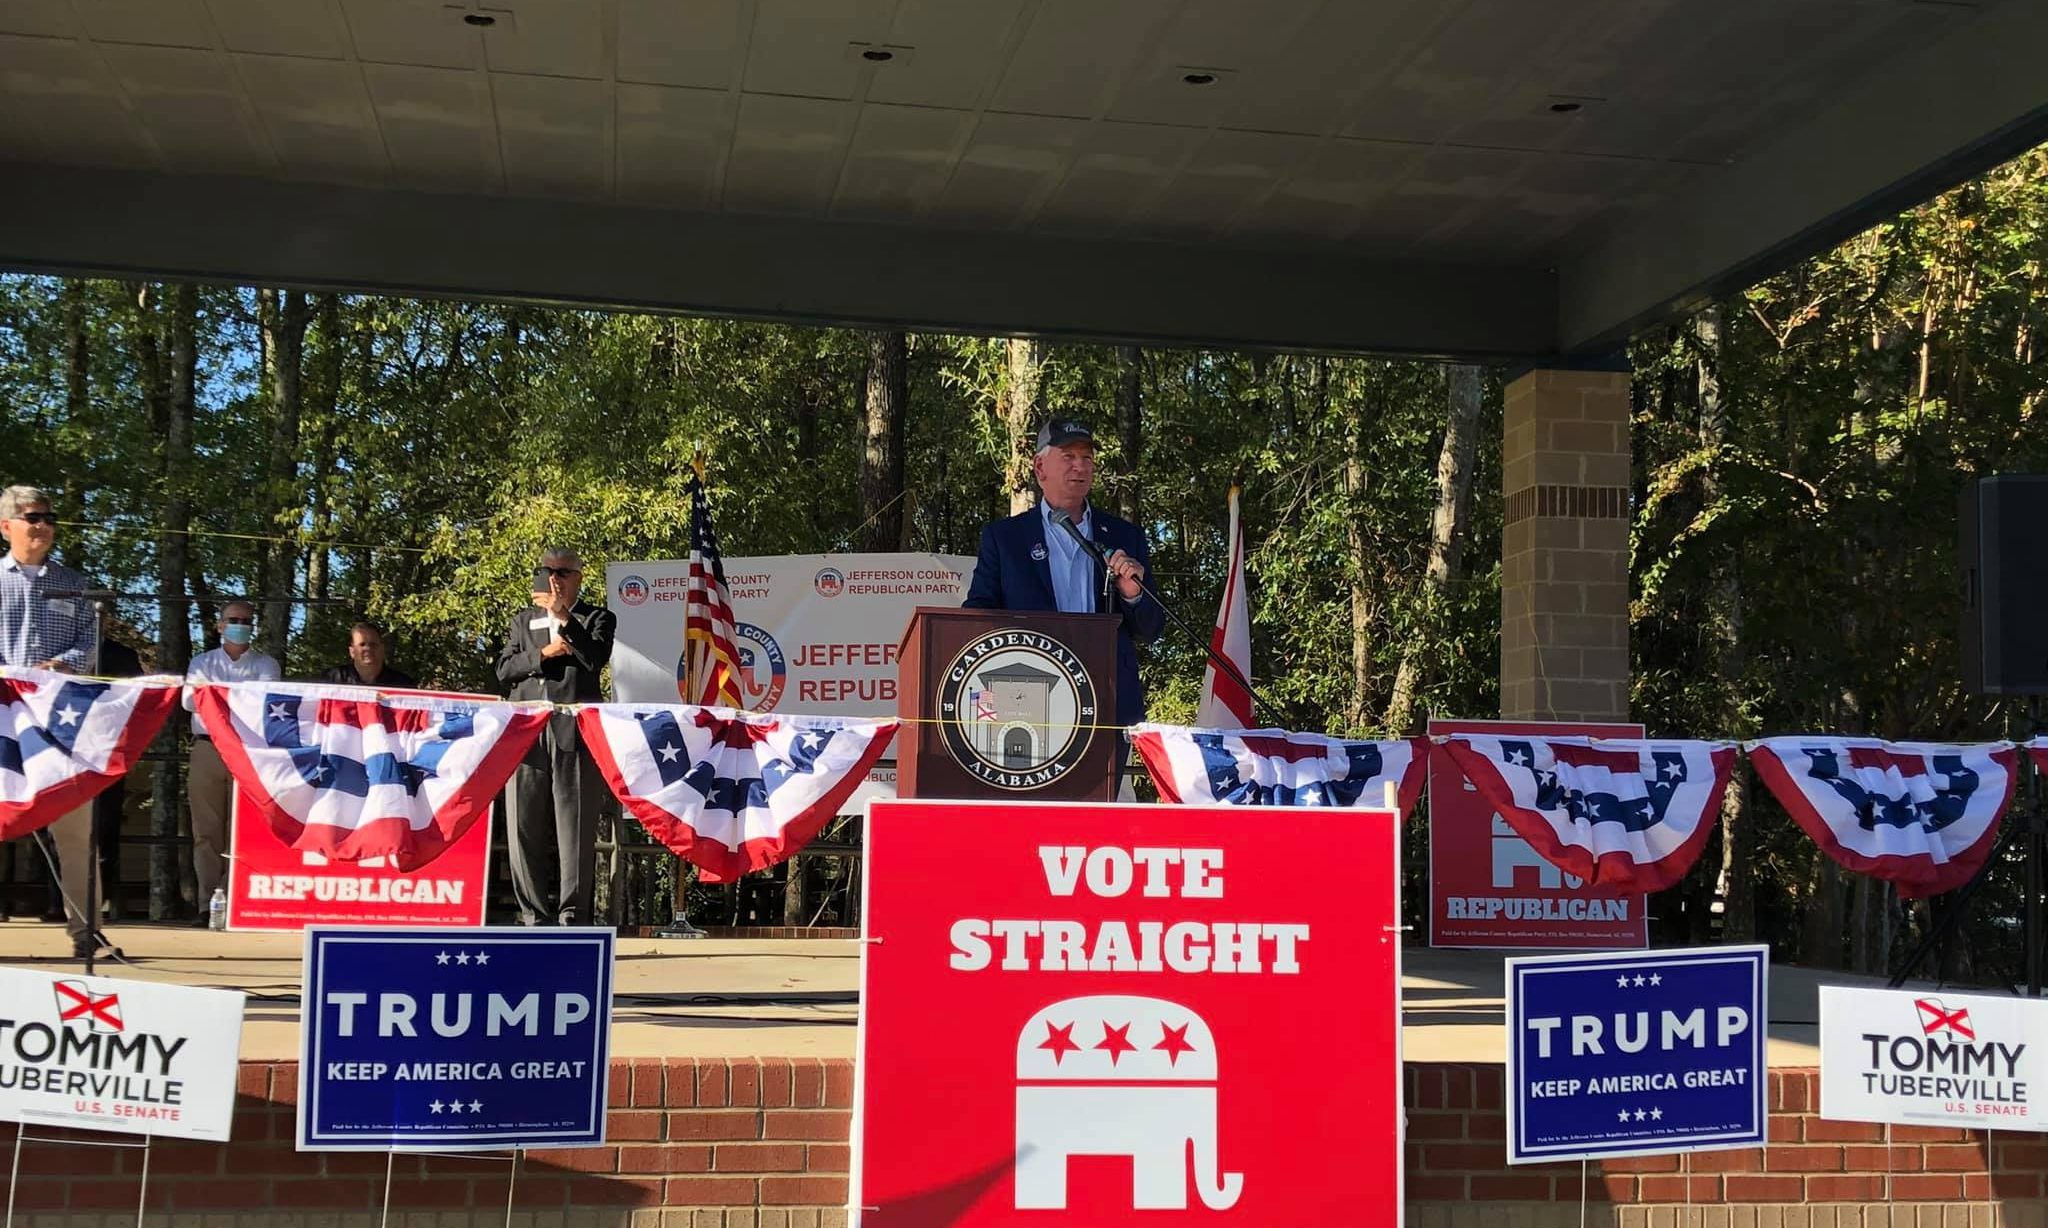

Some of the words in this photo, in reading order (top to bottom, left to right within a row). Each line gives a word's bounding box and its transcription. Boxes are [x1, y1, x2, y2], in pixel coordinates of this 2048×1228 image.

[651, 577, 689, 588] JEFFE
[846, 570, 914, 581] JEFFERSON
[917, 570, 963, 581] COUNTY
[848, 584, 923, 594] REPUBLICAN
[925, 584, 961, 593] PARTY
[732, 588, 770, 599] PARTY
[743, 626, 783, 665] COUNTY
[792, 643, 899, 667] JEFFER
[951, 633, 1087, 687] GARDENDALE
[756, 685, 782, 713] ARTY
[799, 679, 898, 702] REPUB
[943, 703, 954, 712] 19
[1081, 706, 1094, 715] 55
[969, 761, 1067, 787] ALABAMA
[1038, 845, 1224, 899] VOTE
[248, 873, 465, 905] REPUBLICAN
[1446, 896, 1629, 922] REPUBLICAN
[948, 919, 1310, 975] STRAIGHT
[327, 992, 590, 1038] TRUMP
[1527, 1006, 1749, 1059] TRUMP
[1861, 1033, 2026, 1078] TOMMY
[327, 1062, 388, 1081] KEEP
[393, 1062, 503, 1081] AMERICA
[510, 1060, 586, 1079] GREAT
[1531, 1079, 1582, 1098] KEEP
[1587, 1072, 1679, 1095] AMERICA
[1683, 1068, 1748, 1088] GREAT
[0, 1063, 184, 1106] UBERVILLE
[1861, 1072, 2028, 1103] TUBERVILLE
[75, 1100, 105, 1114] U.S.
[113, 1104, 181, 1121] SENATE
[1945, 1102, 1969, 1113] U.S.
[1975, 1104, 2028, 1116] SENATE
